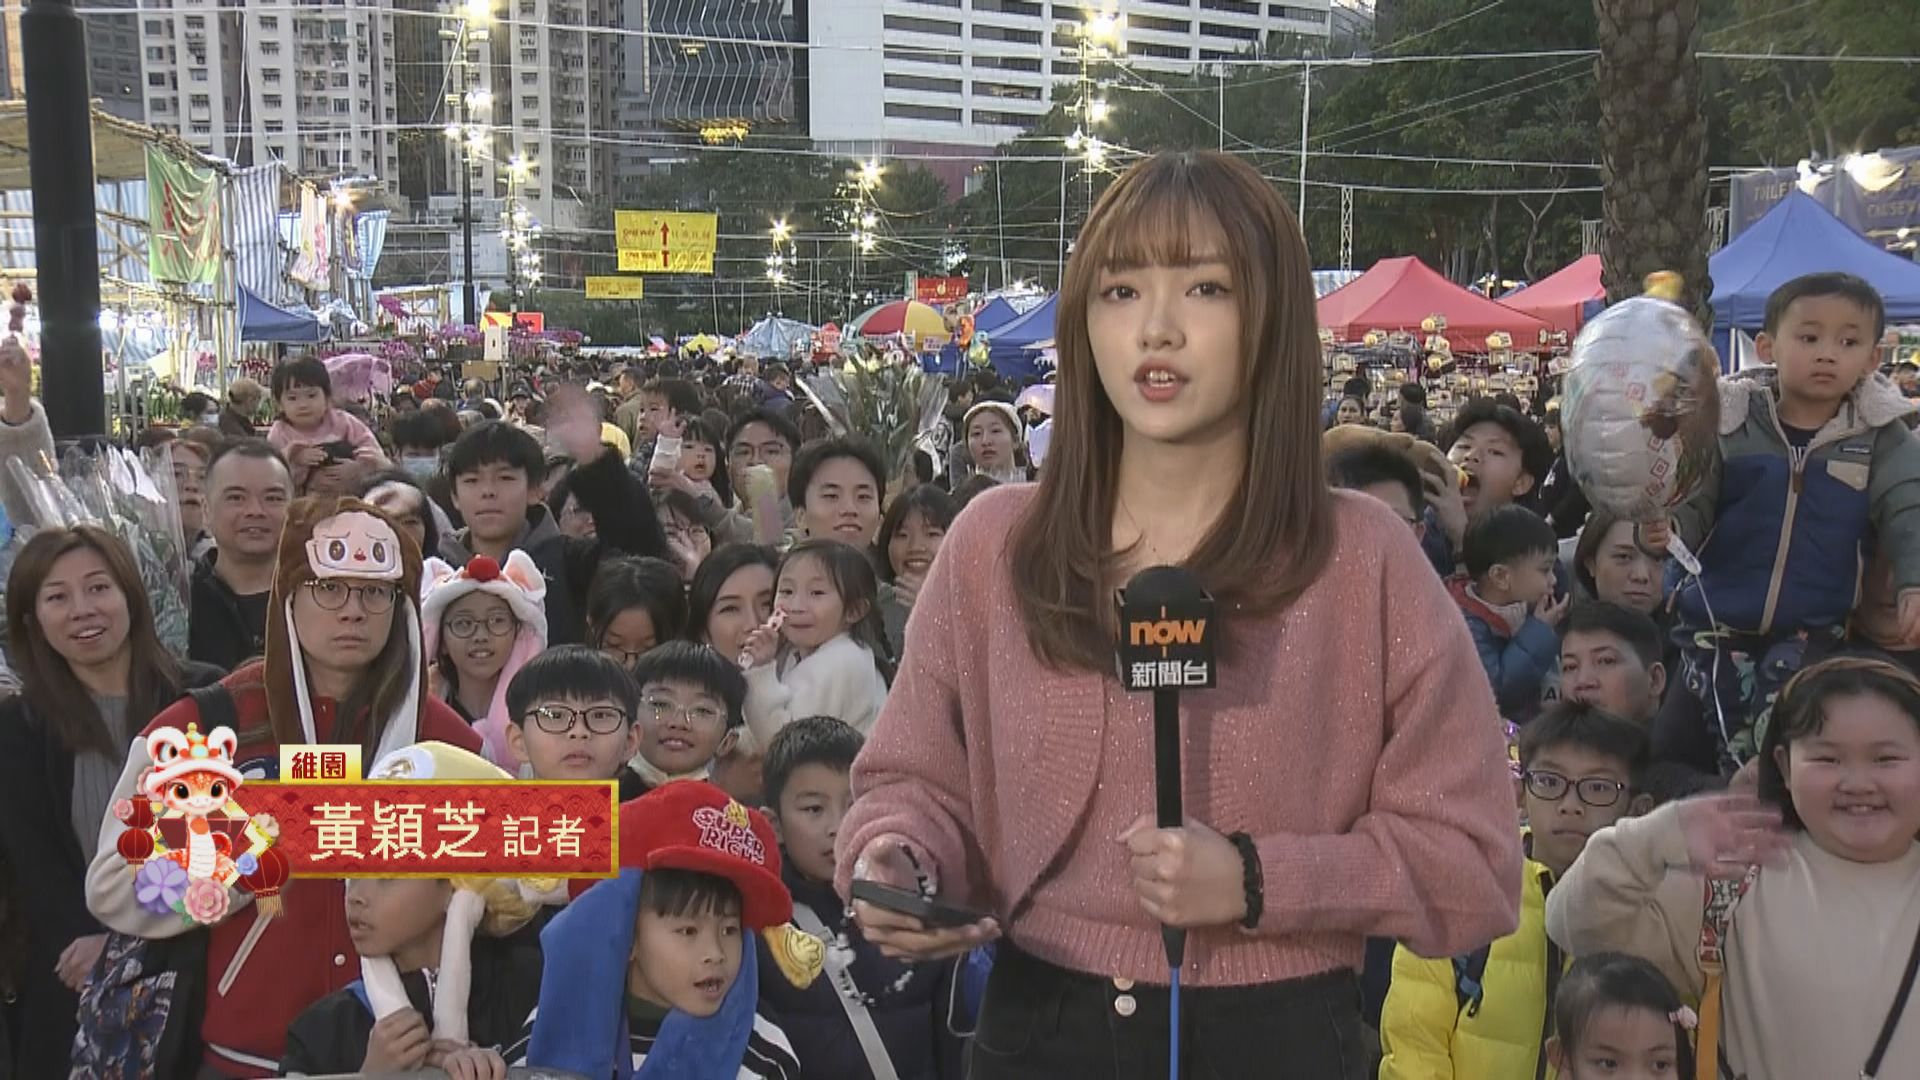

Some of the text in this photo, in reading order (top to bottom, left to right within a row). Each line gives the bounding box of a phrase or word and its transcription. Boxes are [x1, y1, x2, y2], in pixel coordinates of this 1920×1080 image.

[1130, 619, 1206, 646] now
[1131, 660, 1208, 687] 新聞台
[693, 806, 765, 857] SUPER
